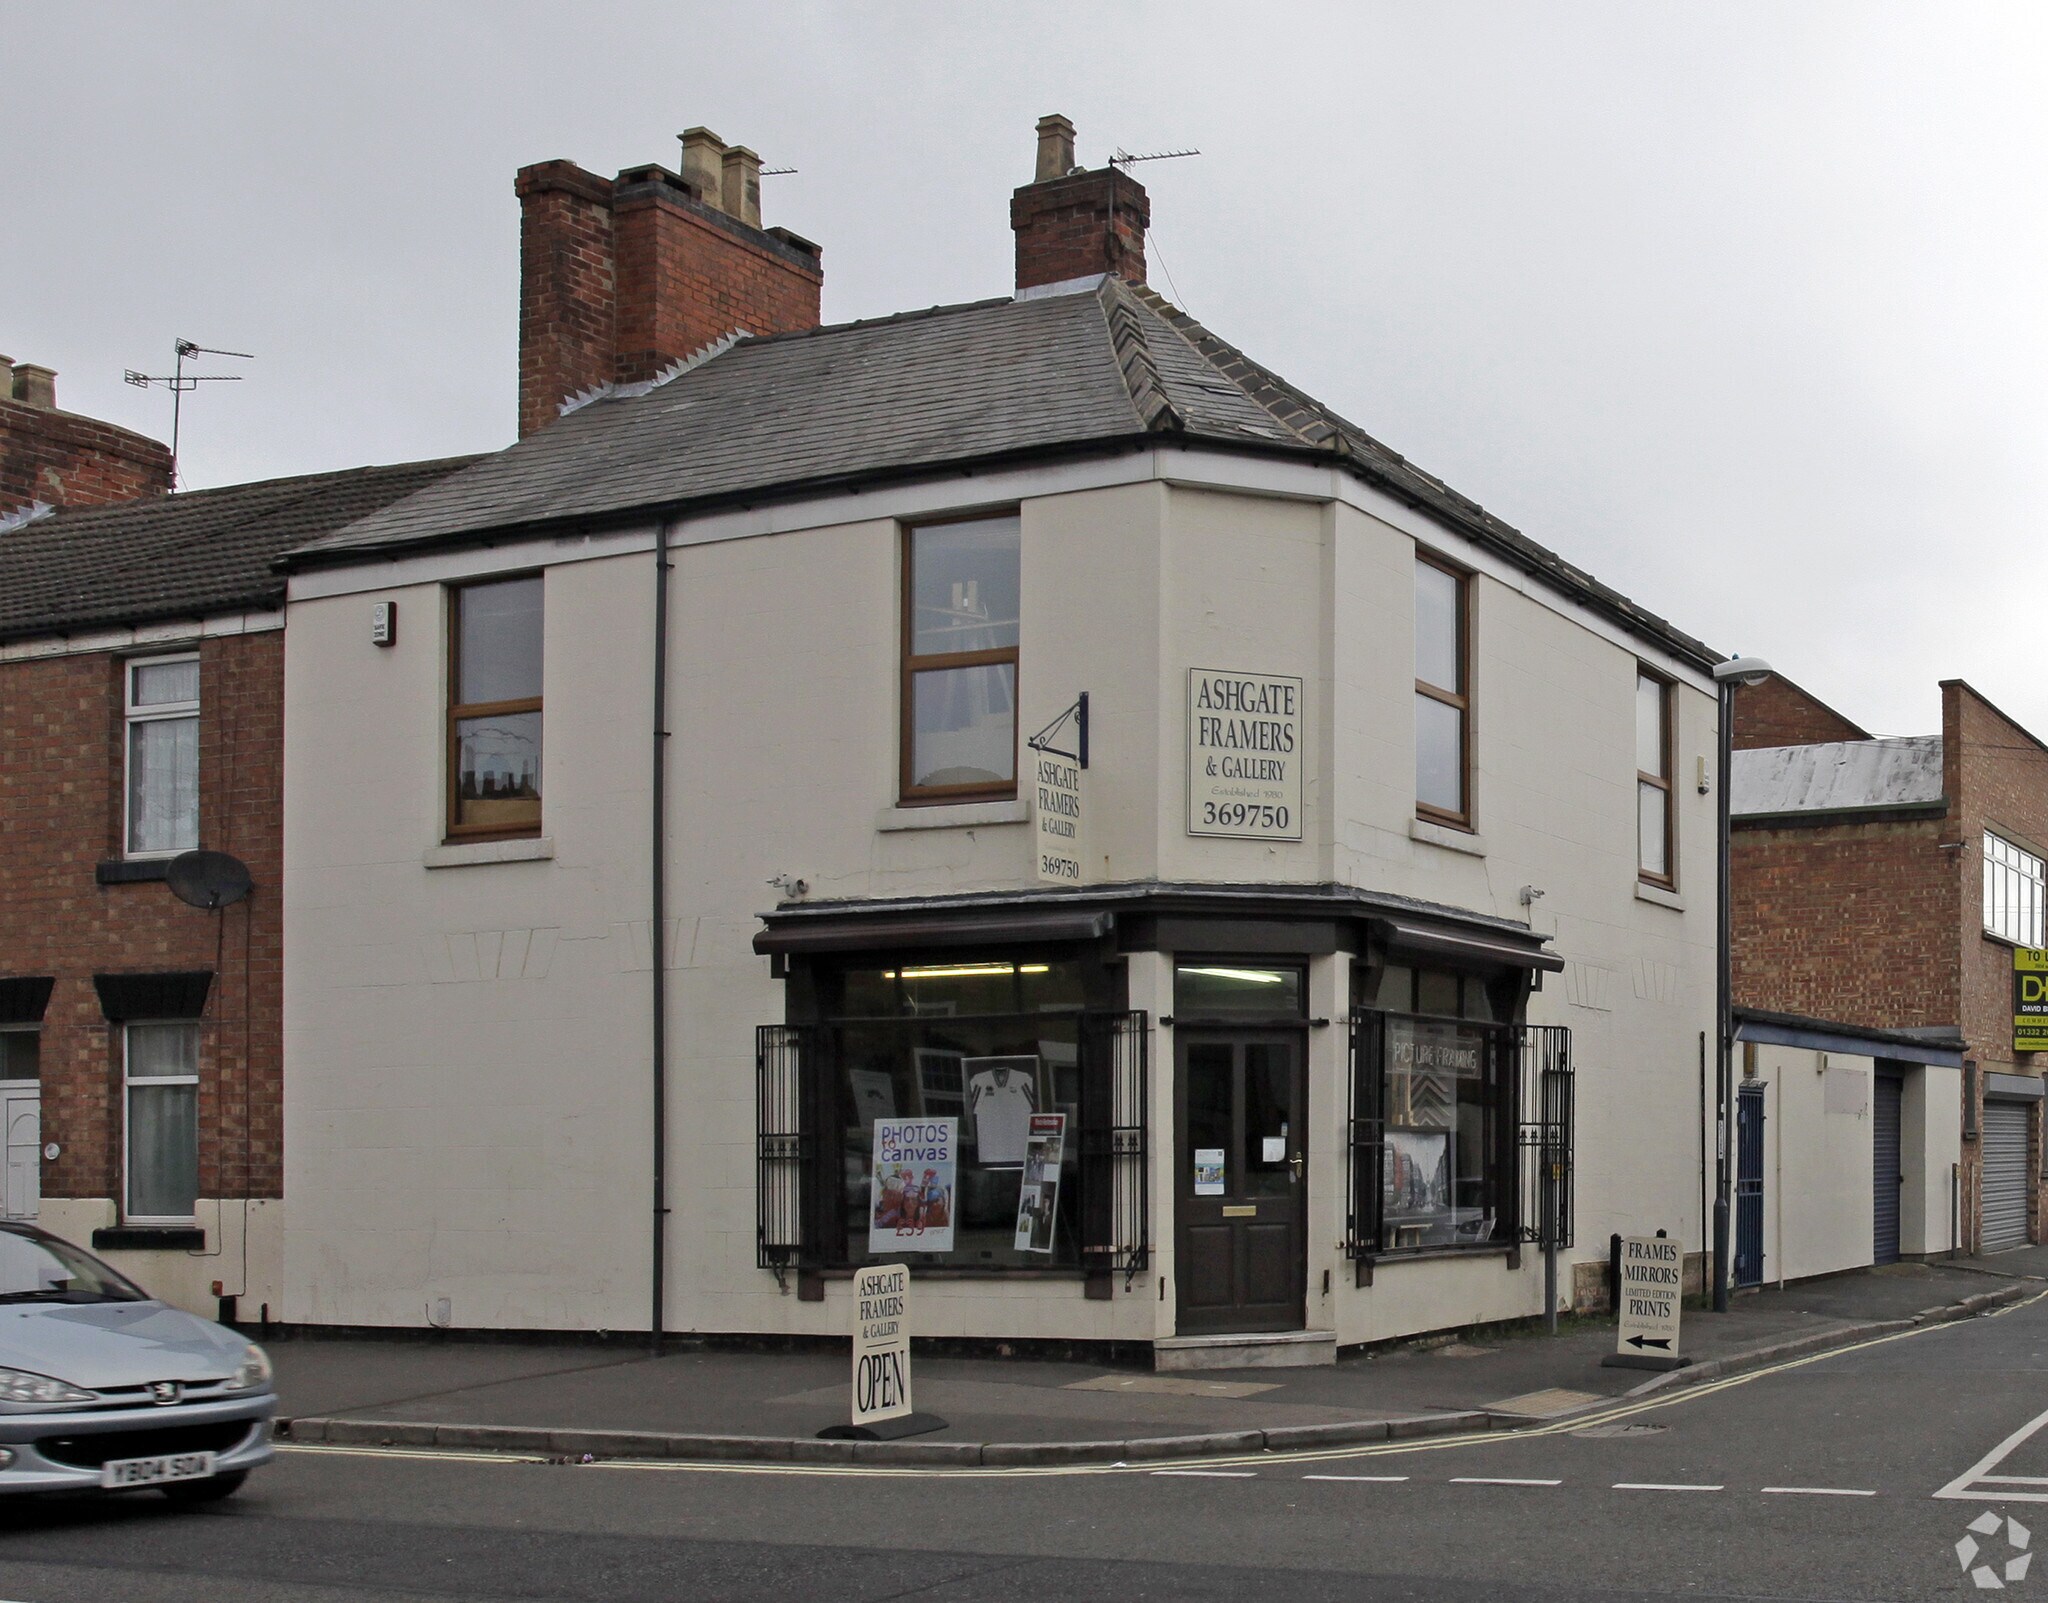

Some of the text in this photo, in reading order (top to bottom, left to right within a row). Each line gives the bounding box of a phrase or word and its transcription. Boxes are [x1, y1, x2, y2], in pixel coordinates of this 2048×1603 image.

[1197, 678, 1295, 716] ASHGATE
[1199, 716, 1294, 753] FRAMERS
[1037, 760, 1079, 792] ASHGATE
[1205, 755, 1286, 782] & GALLERY
[1038, 787, 1080, 818] FRAMERS
[1211, 785, 1283, 799] Established 1980
[1203, 801, 1289, 829] 369750
[1042, 817, 1076, 839] & GALLERY
[1041, 854, 1079, 880] 369750
[2026, 950, 2041, 962] TO
[1394, 1042, 1477, 1069] PICTURE FRAMING
[882, 1124, 948, 1144] PHOTOS
[881, 1146, 948, 1162] canvas
[1628, 1242, 1677, 1262] FRAMES
[859, 1272, 904, 1297] ASHGATE
[1624, 1264, 1679, 1285] MIRRORS
[1625, 1287, 1677, 1300] LIMITED EDITION
[859, 1296, 904, 1321] FRAMERS
[1629, 1299, 1671, 1319] PRINTS
[862, 1321, 899, 1339] & GALLERY
[857, 1350, 905, 1413] OPEN
